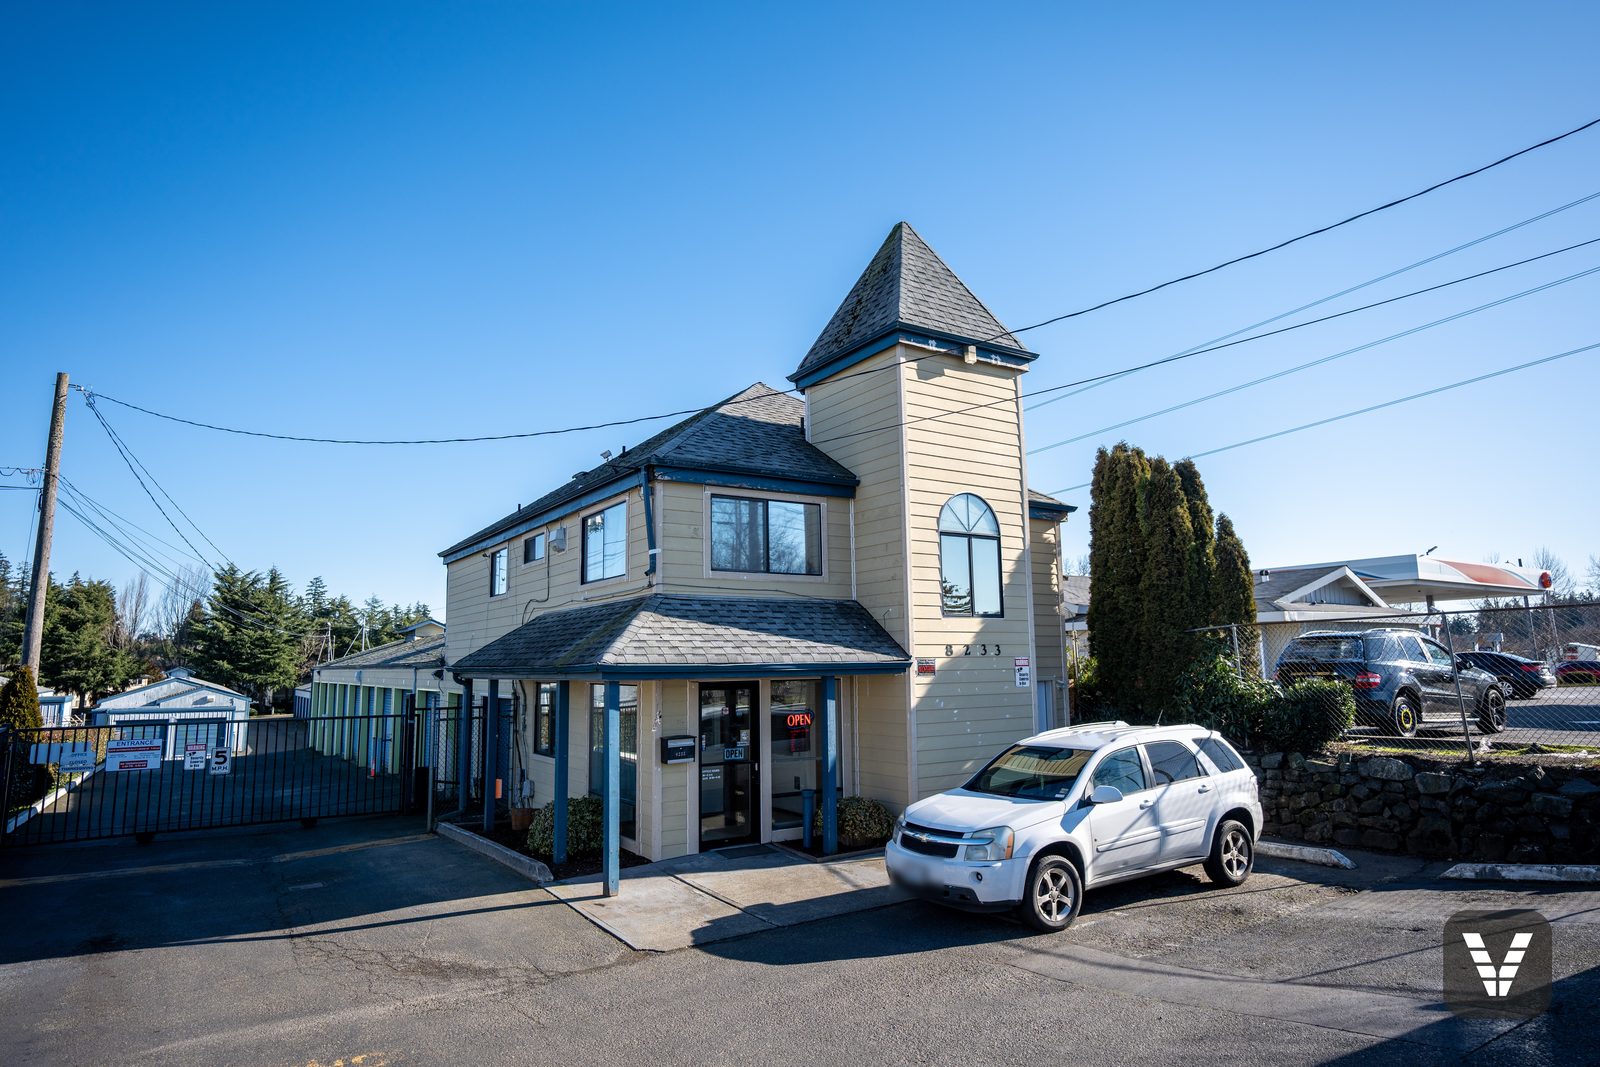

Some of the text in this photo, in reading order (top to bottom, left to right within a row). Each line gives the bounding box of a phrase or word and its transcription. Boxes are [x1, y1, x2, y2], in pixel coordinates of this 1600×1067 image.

[945, 644, 1002, 656] 8233
[787, 713, 811, 727] OPEN
[116, 739, 154, 747] ENTRANCE
[214, 750, 228, 765] 5
[725, 748, 743, 759] OPEN
